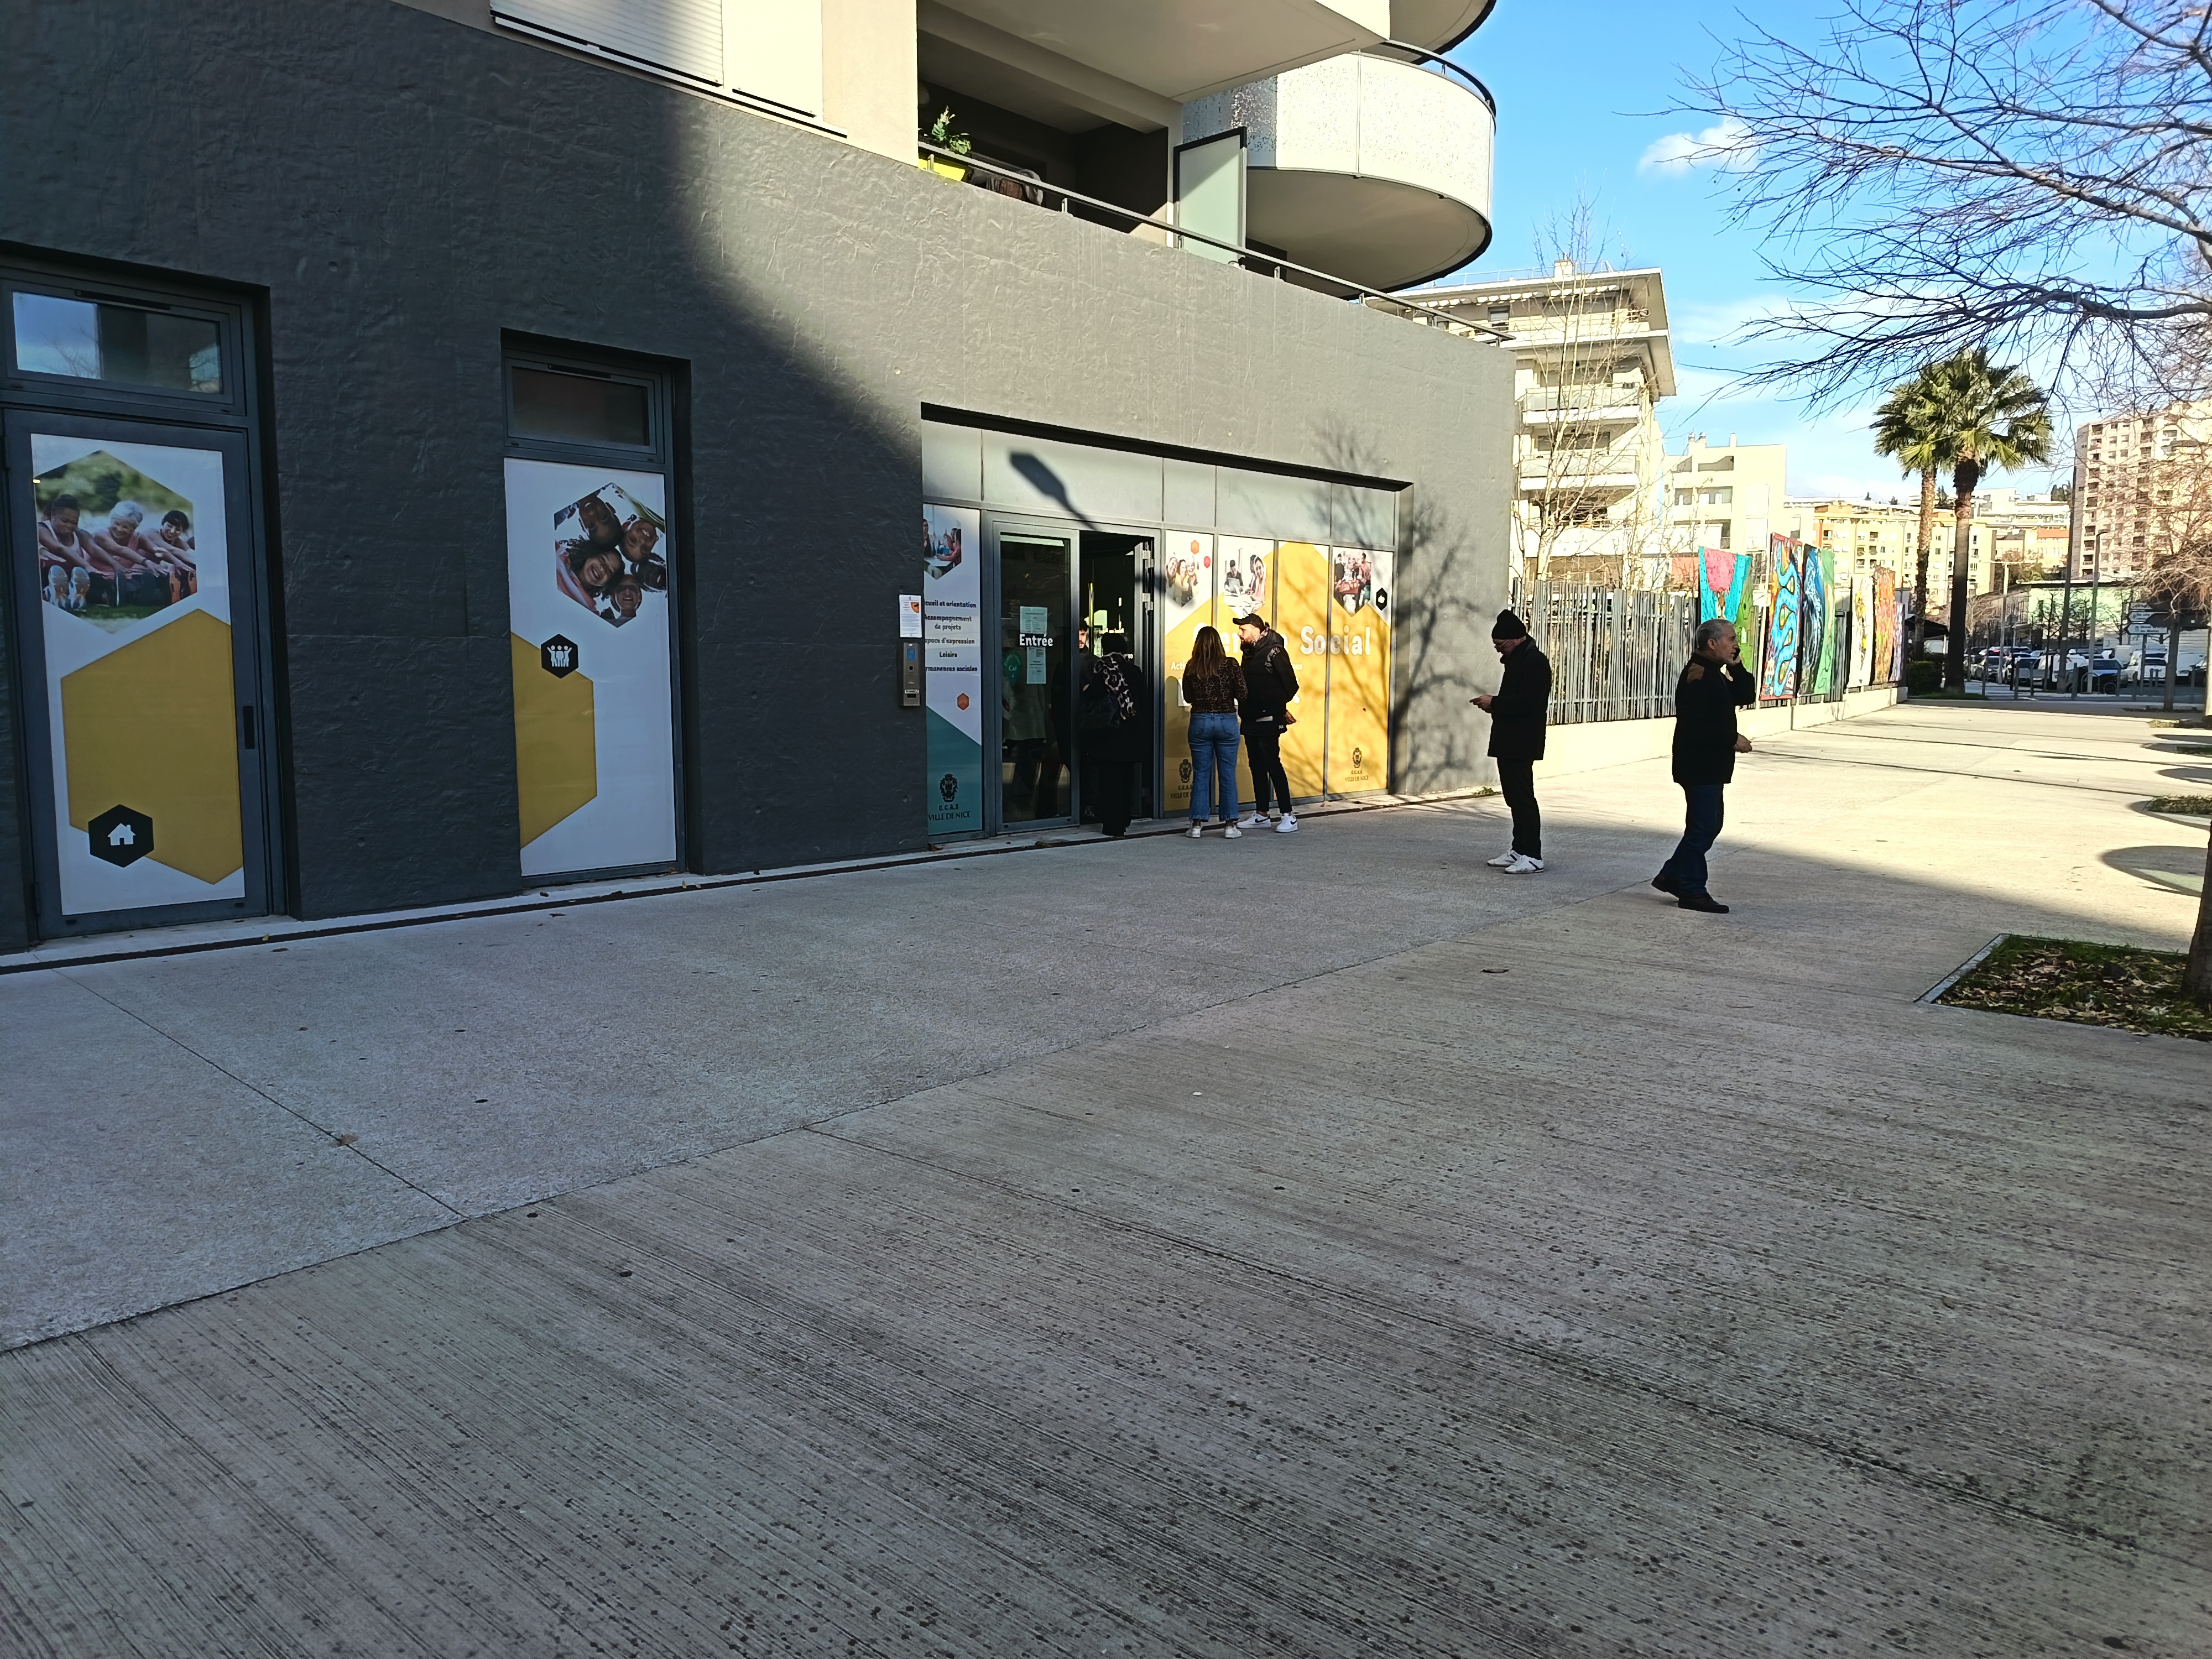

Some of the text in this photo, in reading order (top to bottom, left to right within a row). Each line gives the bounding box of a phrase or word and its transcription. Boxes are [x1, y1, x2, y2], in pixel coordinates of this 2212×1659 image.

[941, 637, 975, 645] d'expression
[1019, 633, 1053, 646] Entrée
[1300, 624, 1371, 655] Social
[946, 812, 955, 820] DE
[955, 811, 971, 819] NICE
